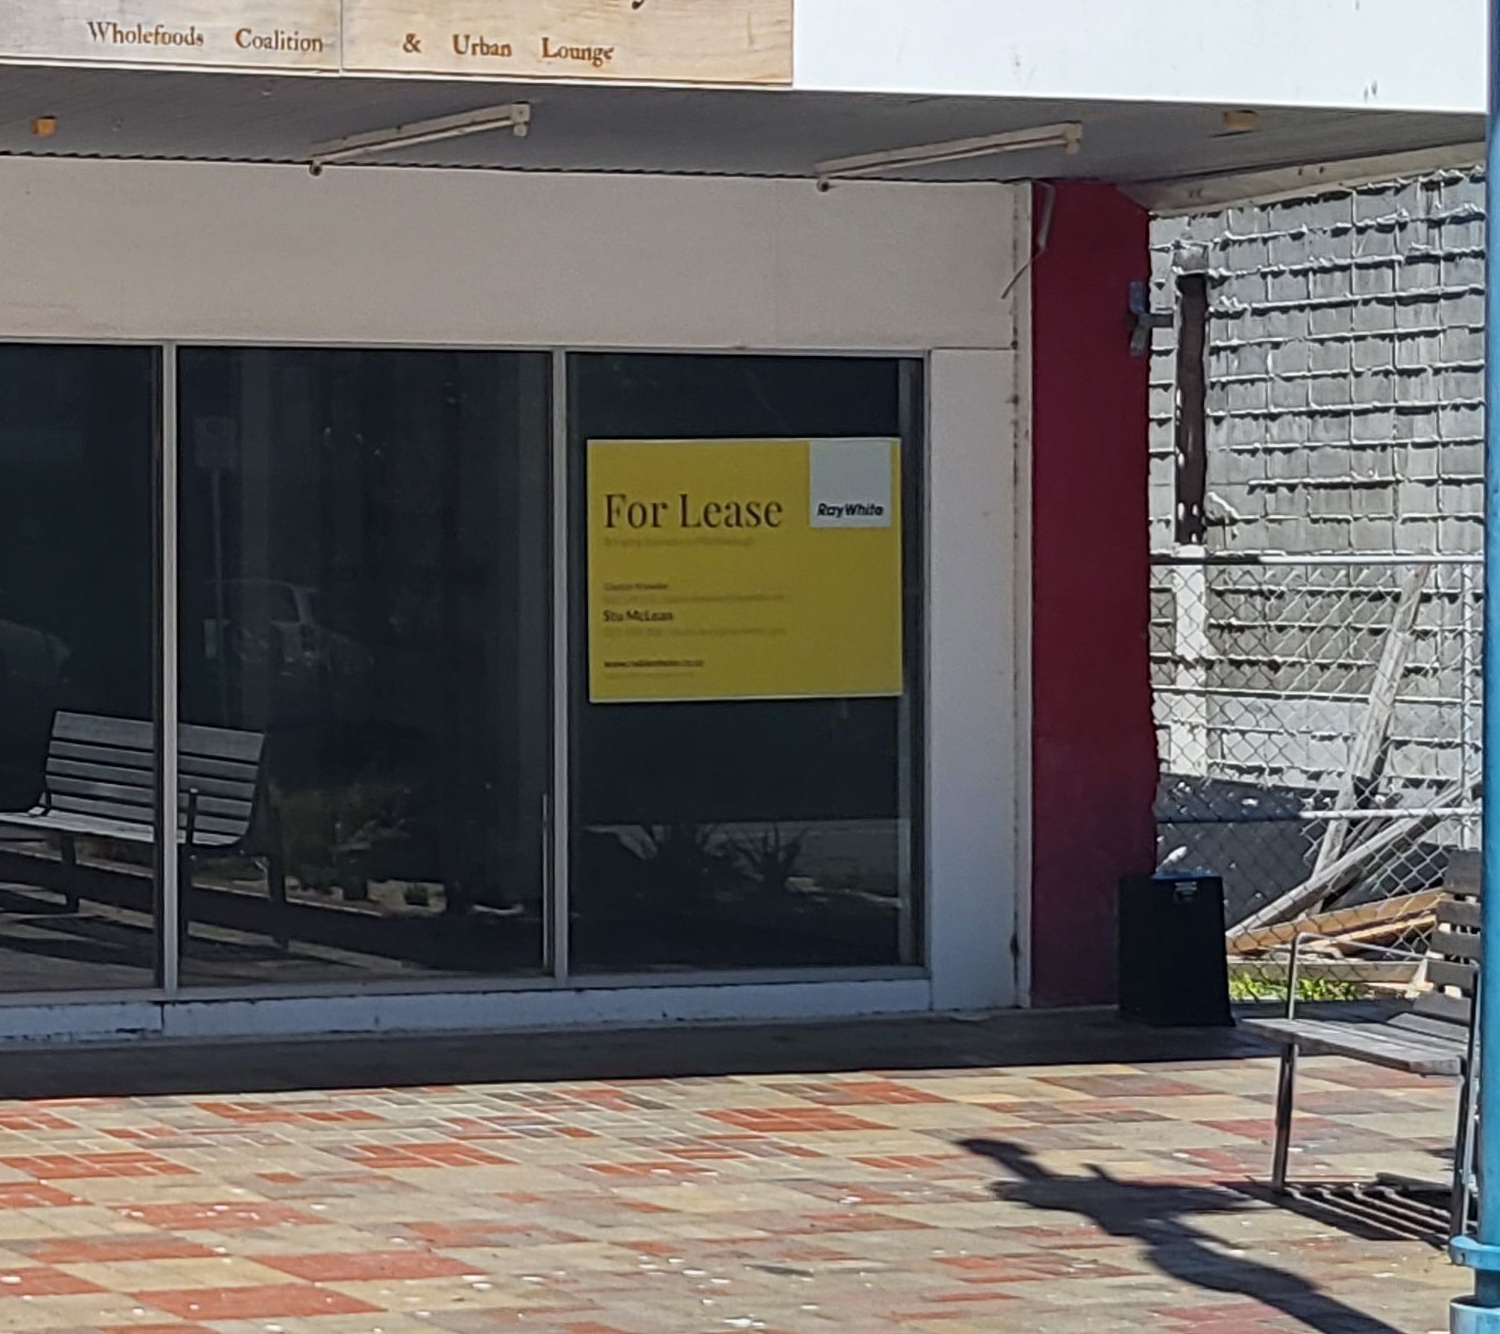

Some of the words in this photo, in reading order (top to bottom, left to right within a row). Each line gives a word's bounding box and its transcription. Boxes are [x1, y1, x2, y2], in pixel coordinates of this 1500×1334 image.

[88, 20, 204, 48] Wholefoods
[235, 27, 324, 53] Coalition
[403, 34, 421, 55] &
[452, 34, 512, 58] Urban
[542, 38, 615, 67] Lounge
[604, 494, 668, 528] For
[680, 494, 783, 528] Lease
